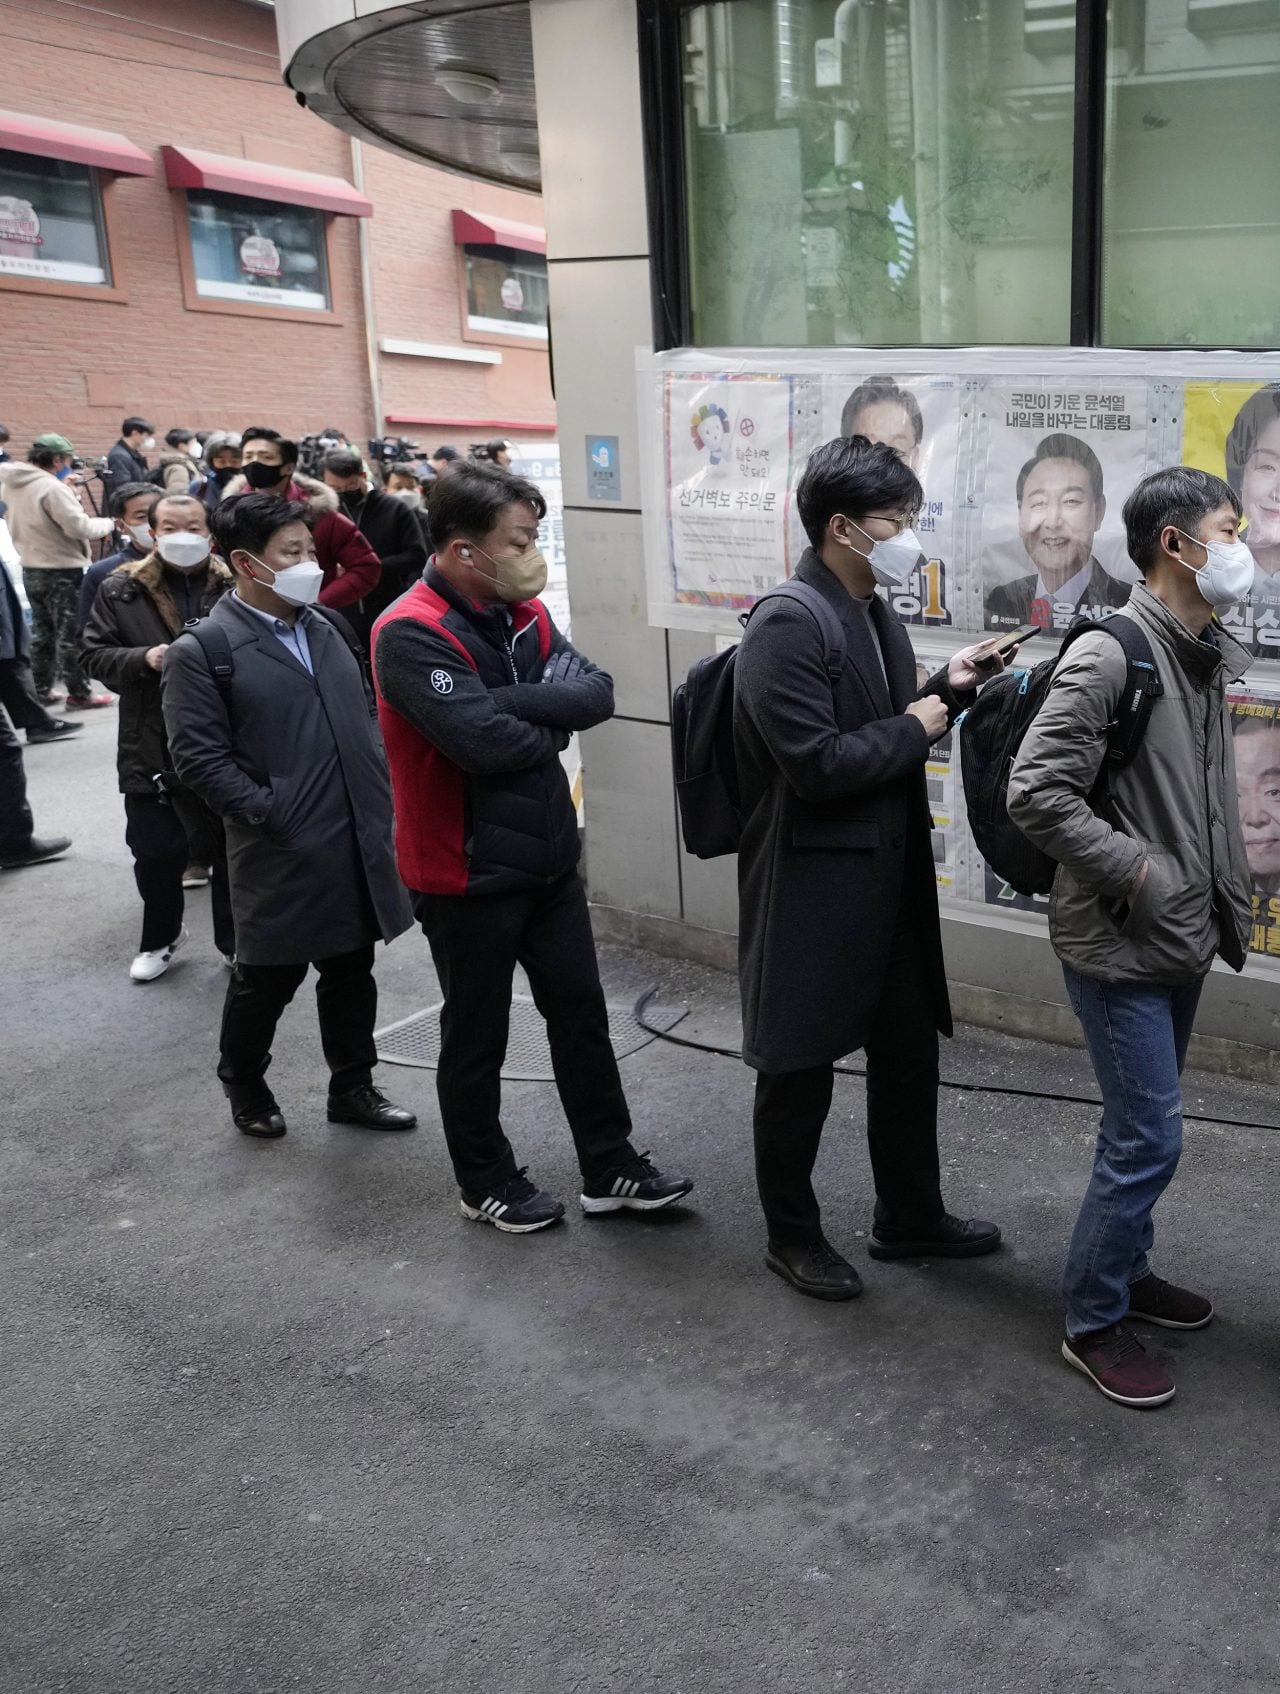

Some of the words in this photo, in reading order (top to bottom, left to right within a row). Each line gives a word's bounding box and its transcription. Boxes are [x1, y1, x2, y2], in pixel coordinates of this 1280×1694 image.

[1011, 393, 1051, 410] 국민이
[1054, 394, 1081, 411] 키운
[1085, 394, 1126, 412] 윤석열
[1006, 411, 1045, 429] 내일을
[1047, 412, 1087, 430] 바꾸는
[1089, 414, 1131, 431] 대통령
[679, 488, 732, 509] 선거벽보
[735, 491, 776, 512] 주의문
[1129, 687, 1143, 713] THULE
